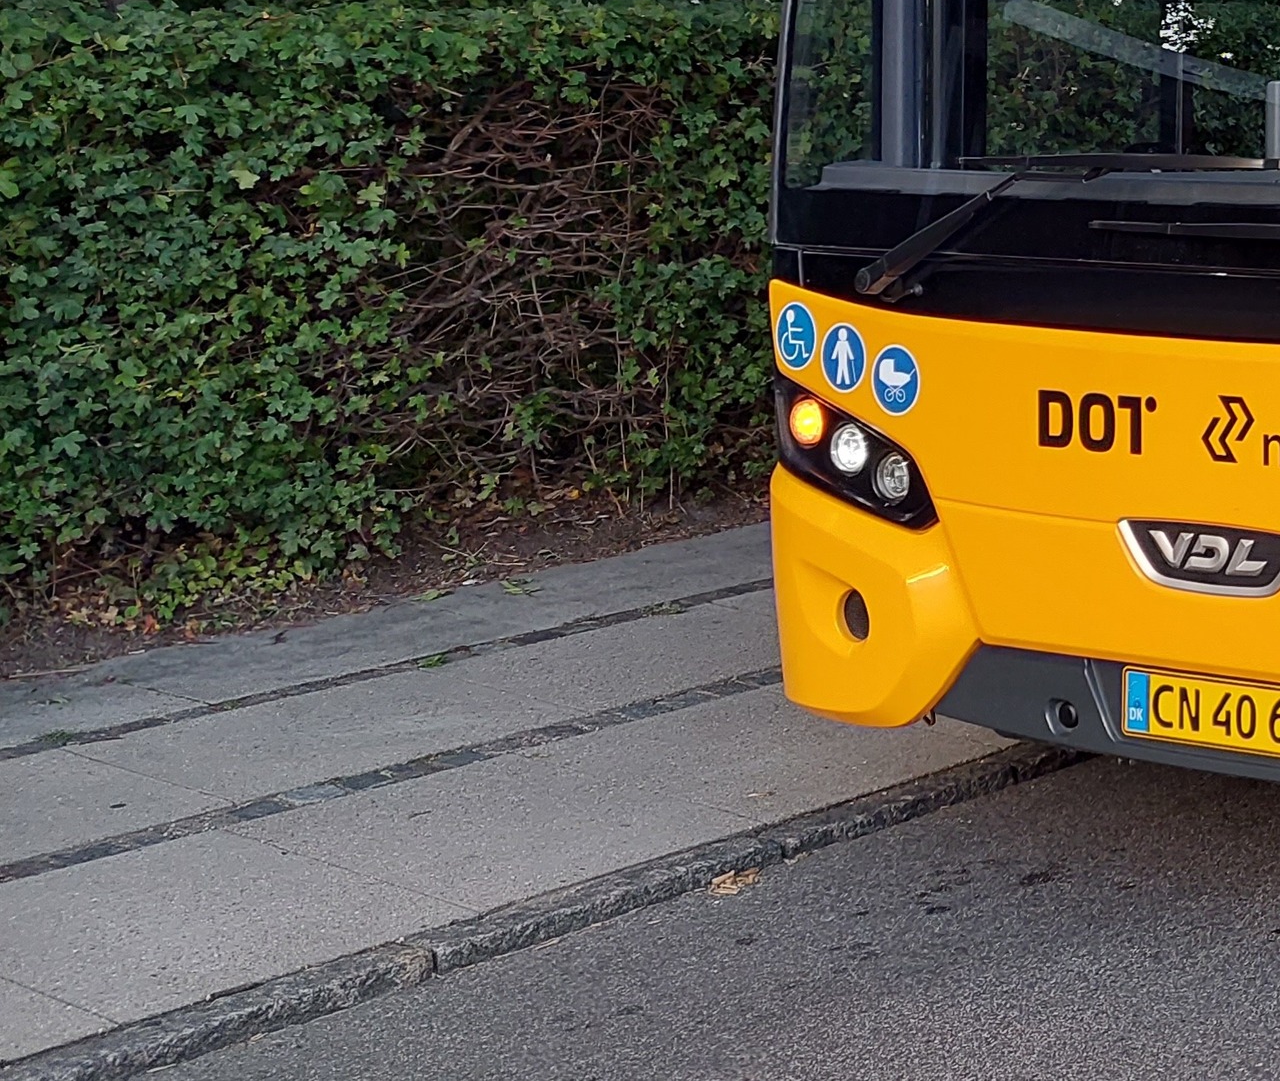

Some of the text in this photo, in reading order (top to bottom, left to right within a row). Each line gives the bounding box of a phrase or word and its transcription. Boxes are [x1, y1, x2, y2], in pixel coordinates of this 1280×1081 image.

[1037, 389, 1157, 455] DOT
[1148, 529, 1268, 577] VDL
[1129, 706, 1143, 722] DK
[1152, 684, 1201, 733] CN
[1212, 692, 1257, 740] 40
